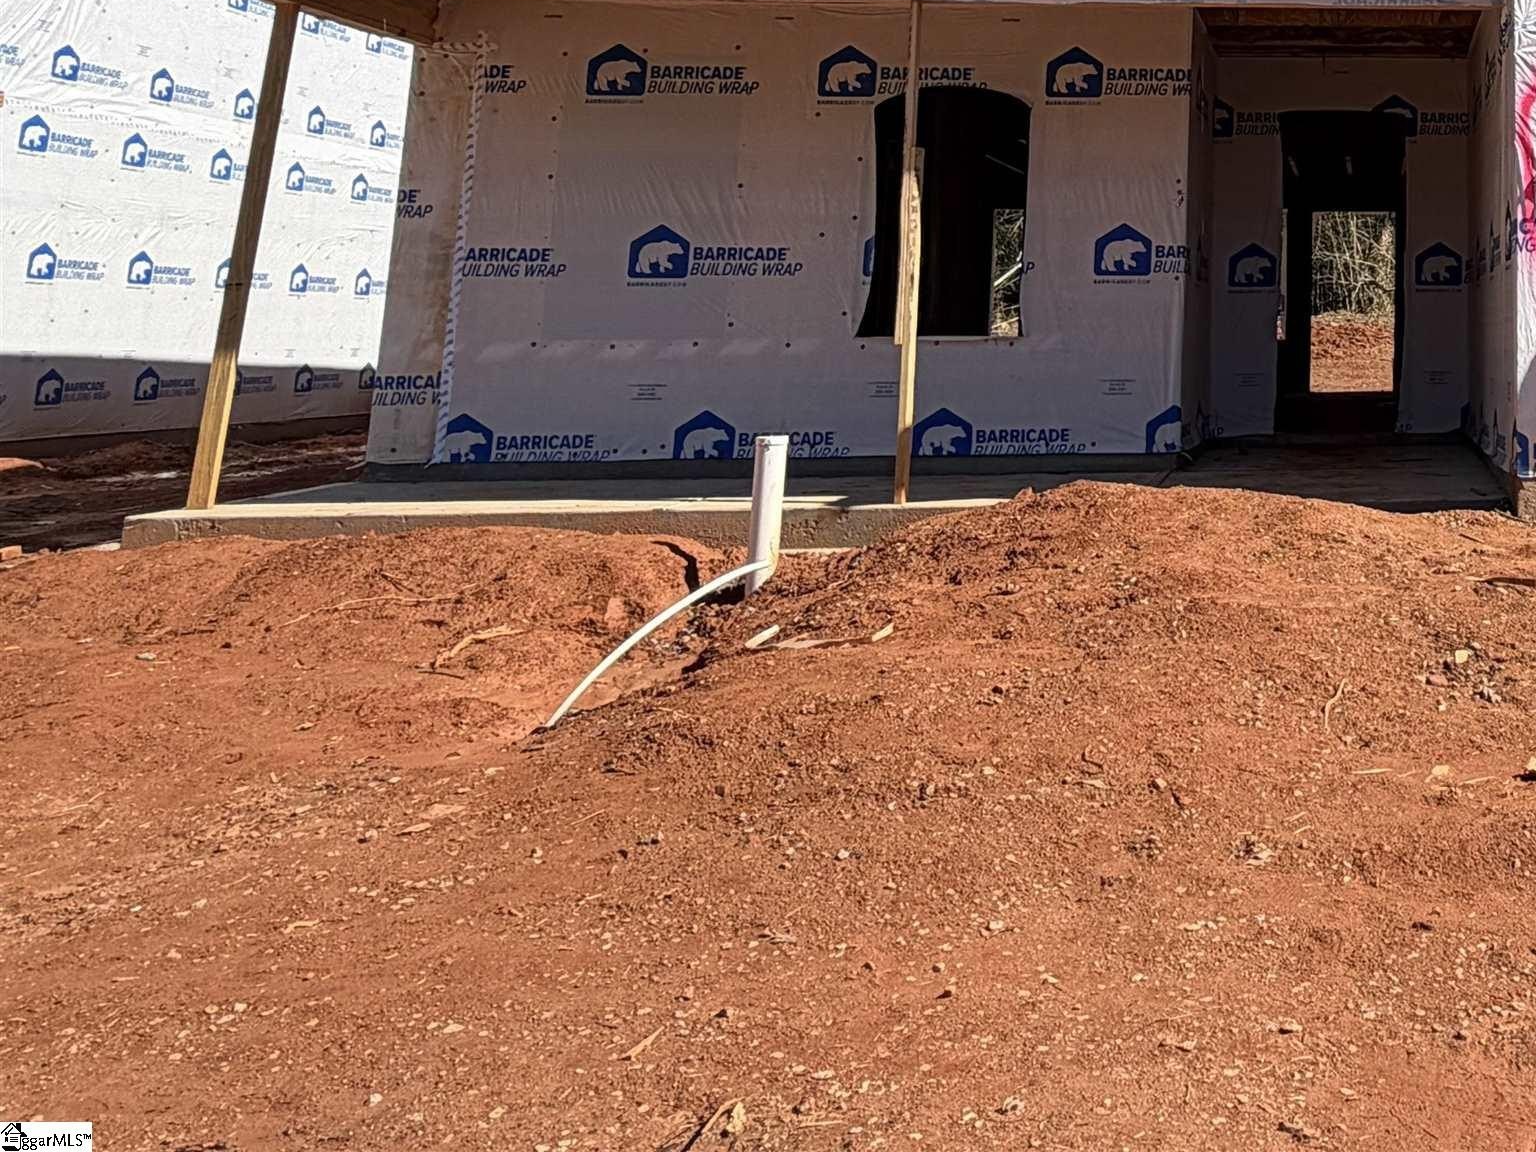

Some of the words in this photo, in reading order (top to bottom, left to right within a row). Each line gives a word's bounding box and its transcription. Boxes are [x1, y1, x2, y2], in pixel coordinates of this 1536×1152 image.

[650, 66, 746, 80] BARRICADE
[484, 80, 527, 92] WRAP
[648, 80, 713, 94] BUILDING
[718, 82, 759, 94] WRAP
[1105, 83, 1169, 96] BUILDING
[693, 248, 788, 262] BARRICADE
[58, 258, 98, 270] BARRICADE
[524, 264, 567, 276] WRAP
[690, 262, 757, 276] BUILDING
[762, 262, 802, 276] WRAP
[496, 435, 594, 450] BARRICADE
[976, 429, 1069, 444] BARRICADE
